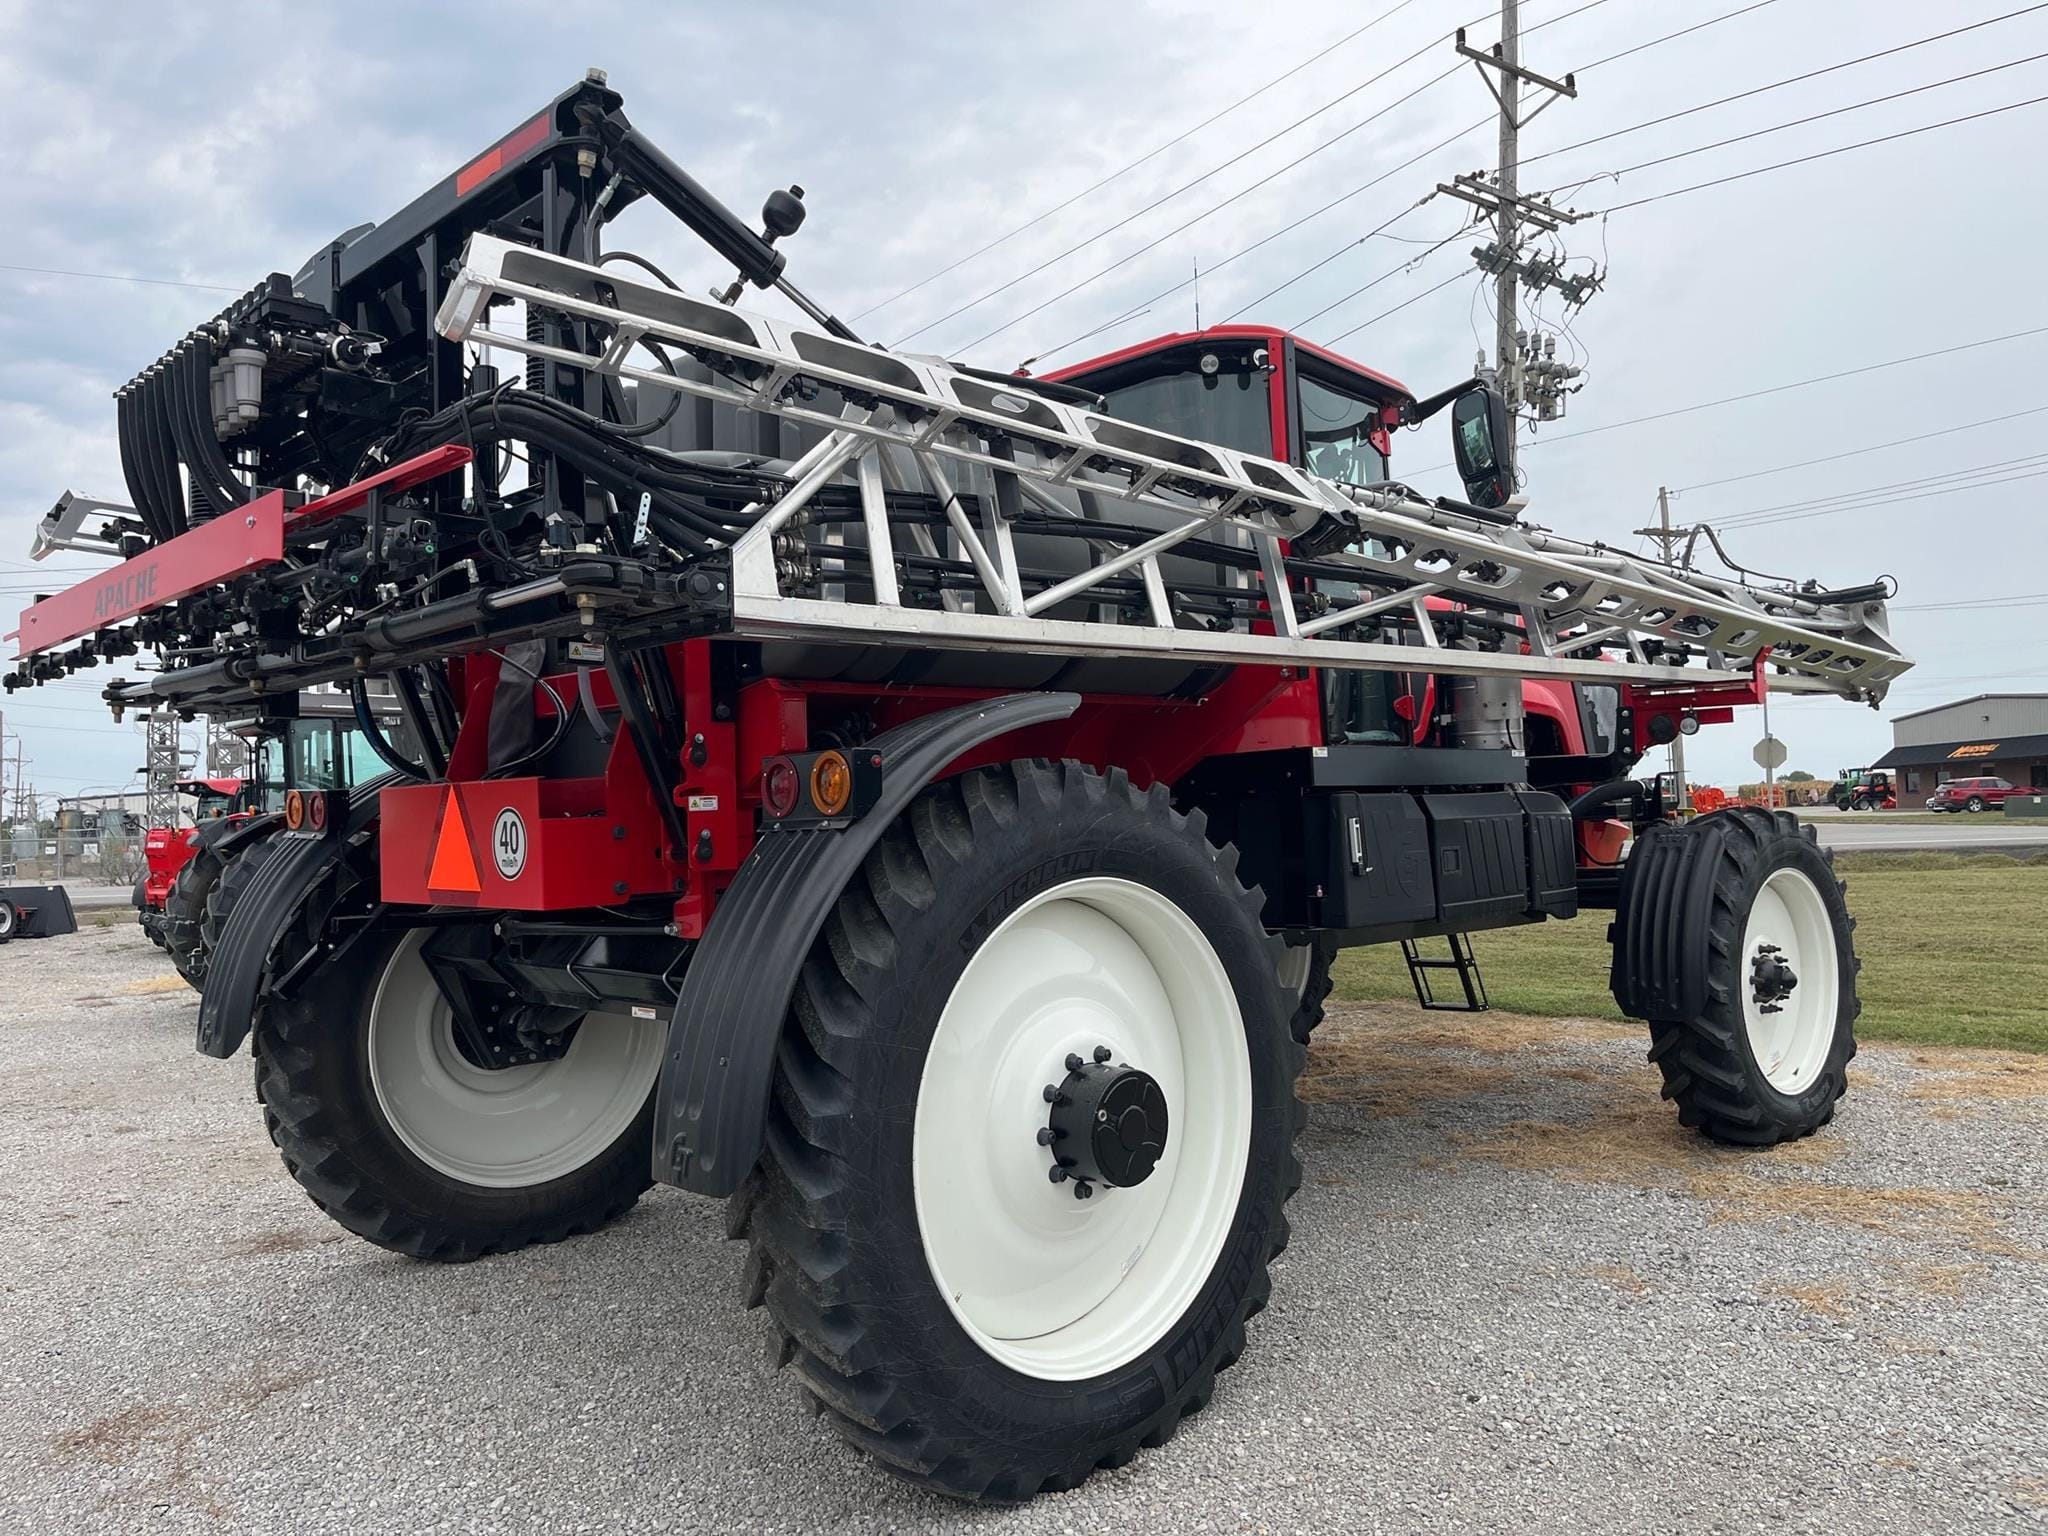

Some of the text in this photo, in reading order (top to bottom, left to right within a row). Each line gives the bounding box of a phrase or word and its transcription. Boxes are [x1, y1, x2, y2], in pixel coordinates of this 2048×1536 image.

[94, 562, 158, 618] APACHE
[500, 820, 519, 854] 40
[986, 850, 1097, 924] MICHELIN
